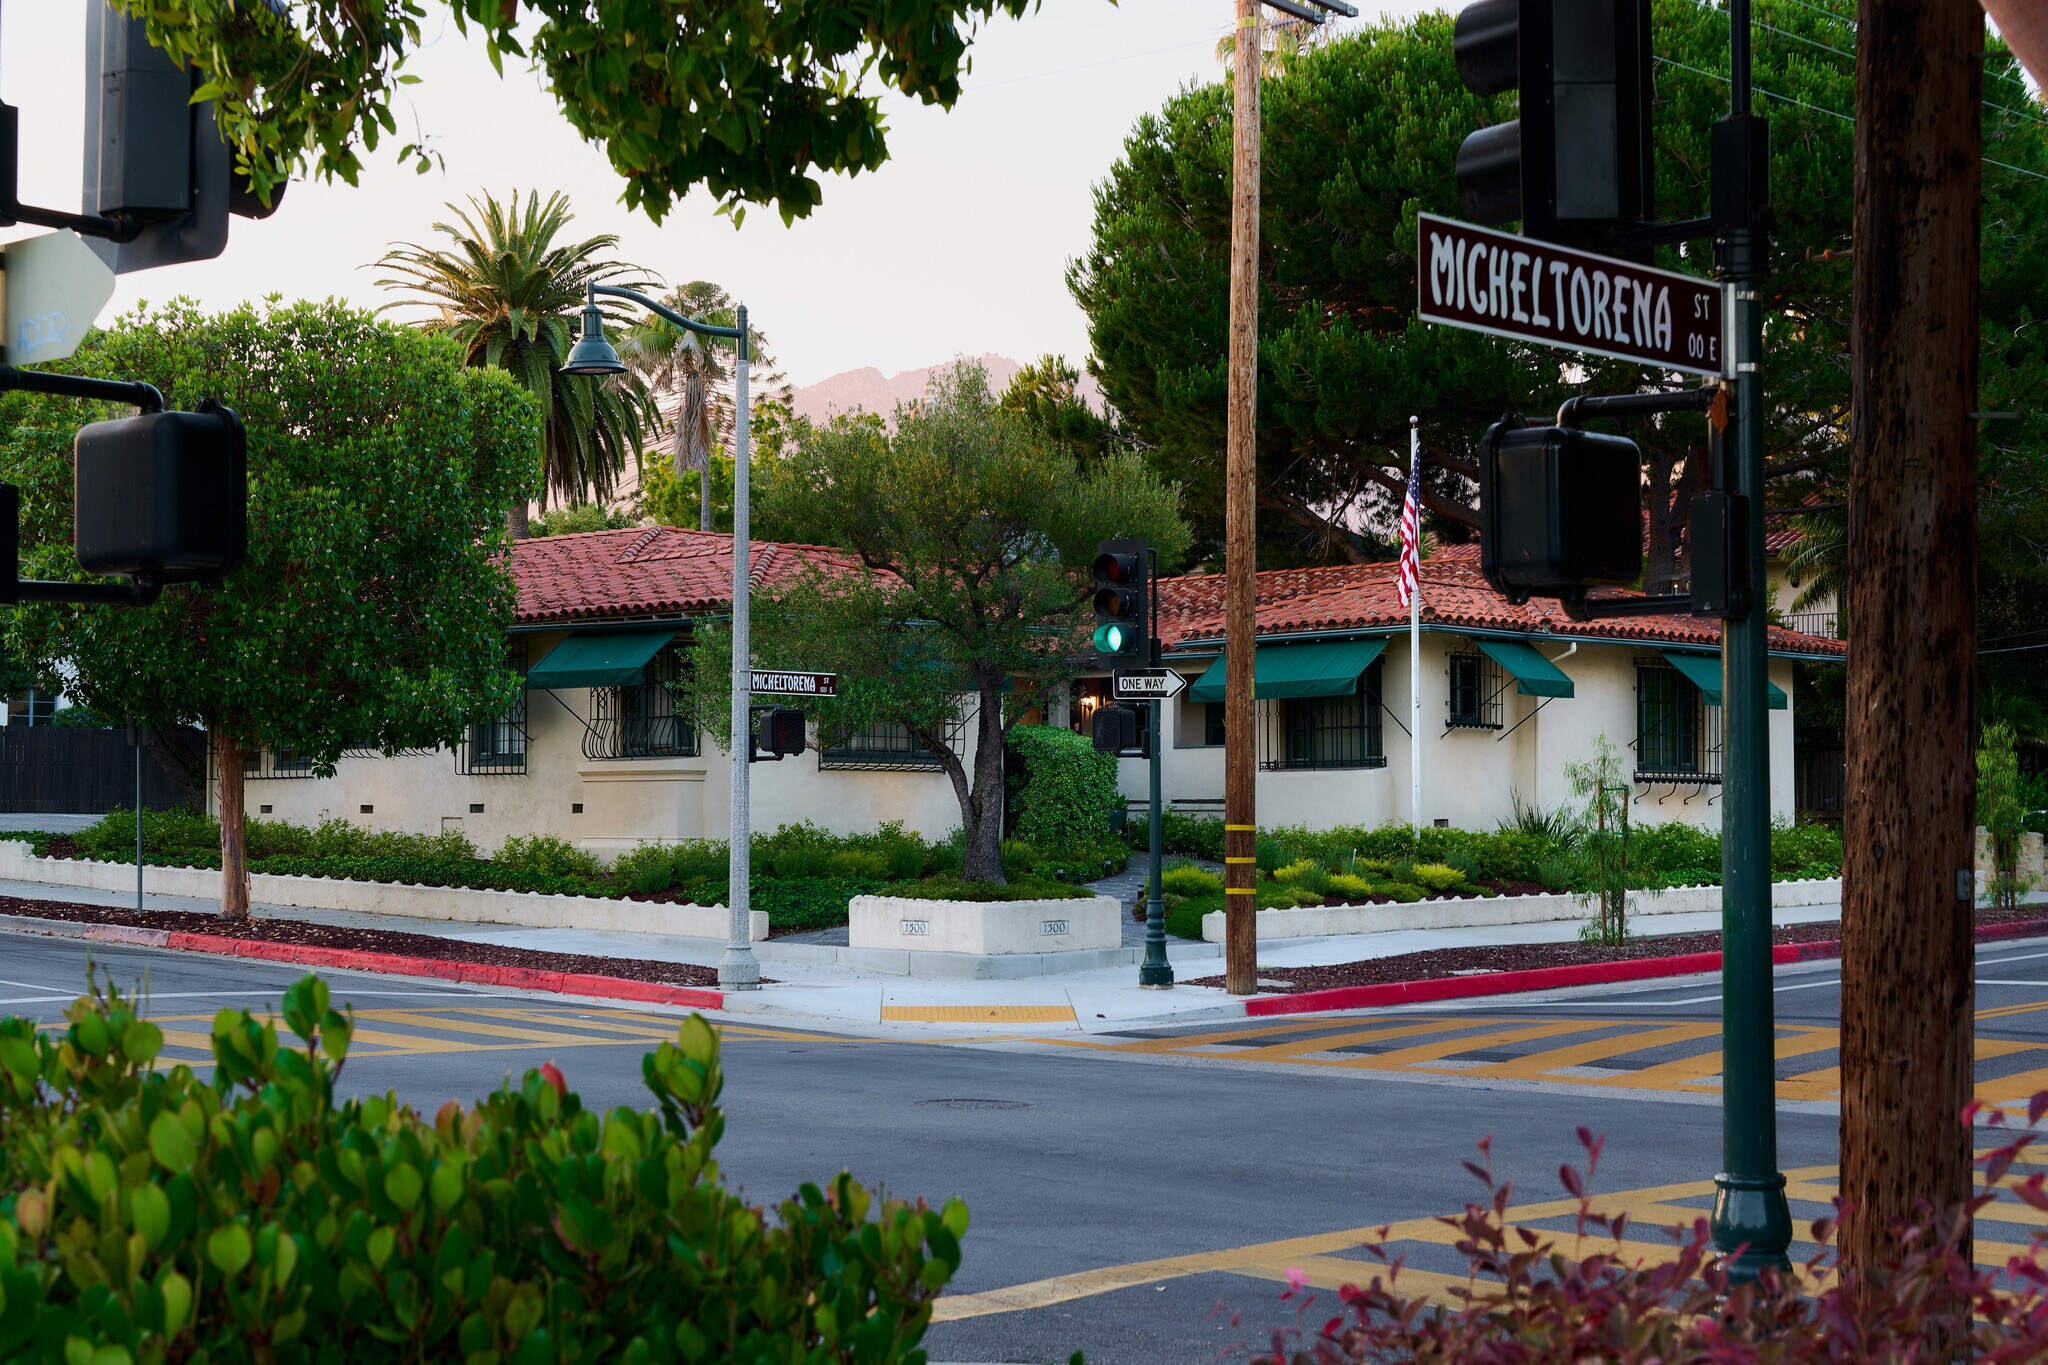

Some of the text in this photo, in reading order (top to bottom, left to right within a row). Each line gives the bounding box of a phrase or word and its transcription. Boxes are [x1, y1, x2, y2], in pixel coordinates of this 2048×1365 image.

[1430, 231, 1710, 353] MICHELTORENA ST
[1688, 332, 1717, 361] 00 E
[752, 673, 816, 692] MICHELTORENA
[1121, 678, 1165, 690] ONE WAY
[905, 923, 926, 933] 1500
[1044, 922, 1065, 933] 1500
